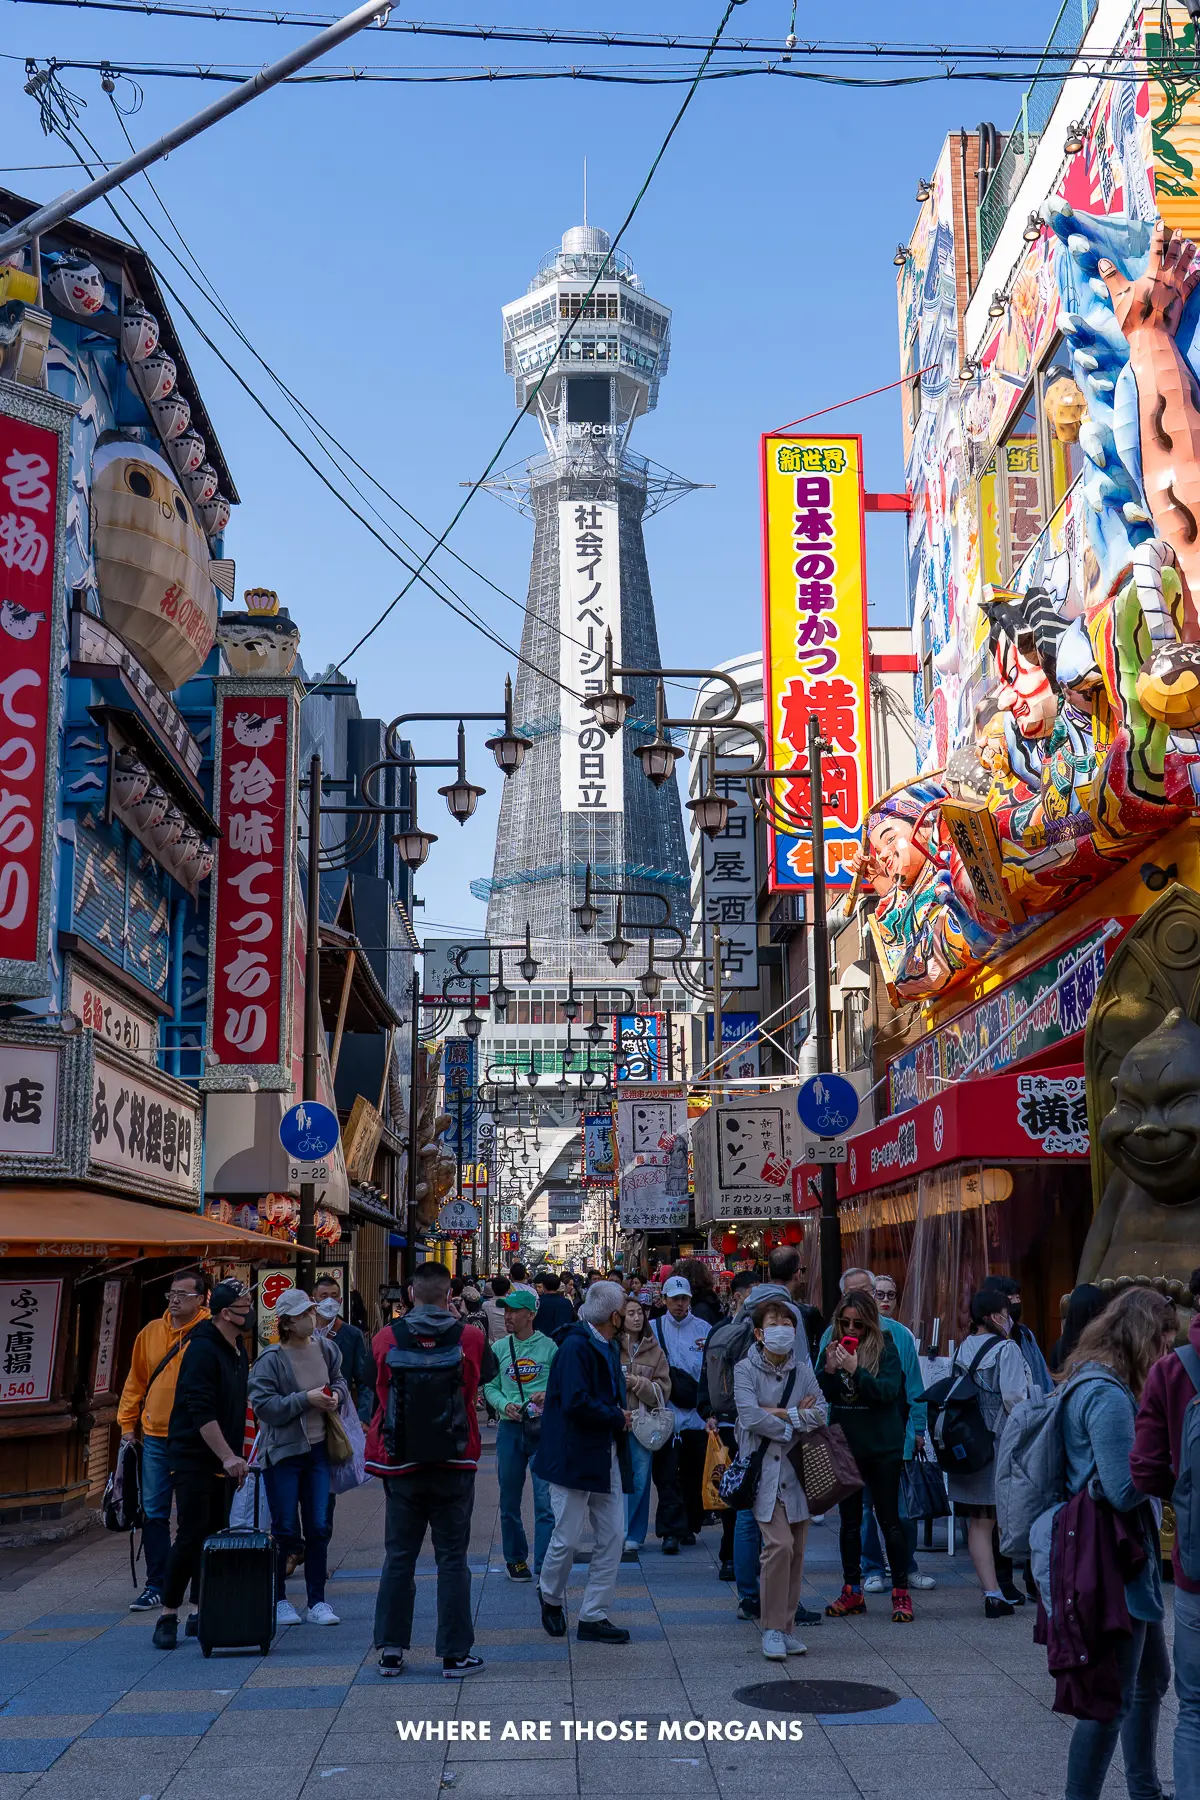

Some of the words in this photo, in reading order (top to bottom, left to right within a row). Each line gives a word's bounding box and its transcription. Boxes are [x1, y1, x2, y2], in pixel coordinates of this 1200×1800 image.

[565, 424, 616, 435] HITACHI
[778, 446, 846, 473] 新世界
[794, 476, 838, 675] 日本一の串かつ
[781, 679, 859, 830] 横綱
[224, 757, 276, 1053] 珍味てっちり
[83, 990, 141, 1048] 名物てっちり
[3, 1078, 44, 1124] 店
[621, 1089, 684, 1099] 元祖串カツ専門店
[92, 1077, 192, 1176] ふぐ料理専門
[721, 1194, 731, 1203] 1F
[733, 1193, 792, 1204] カウンター席
[721, 1206, 731, 1215] 2F
[733, 1205, 792, 1216] 座敷あります
[3, 1288, 39, 1375] ふぐ唐揚
